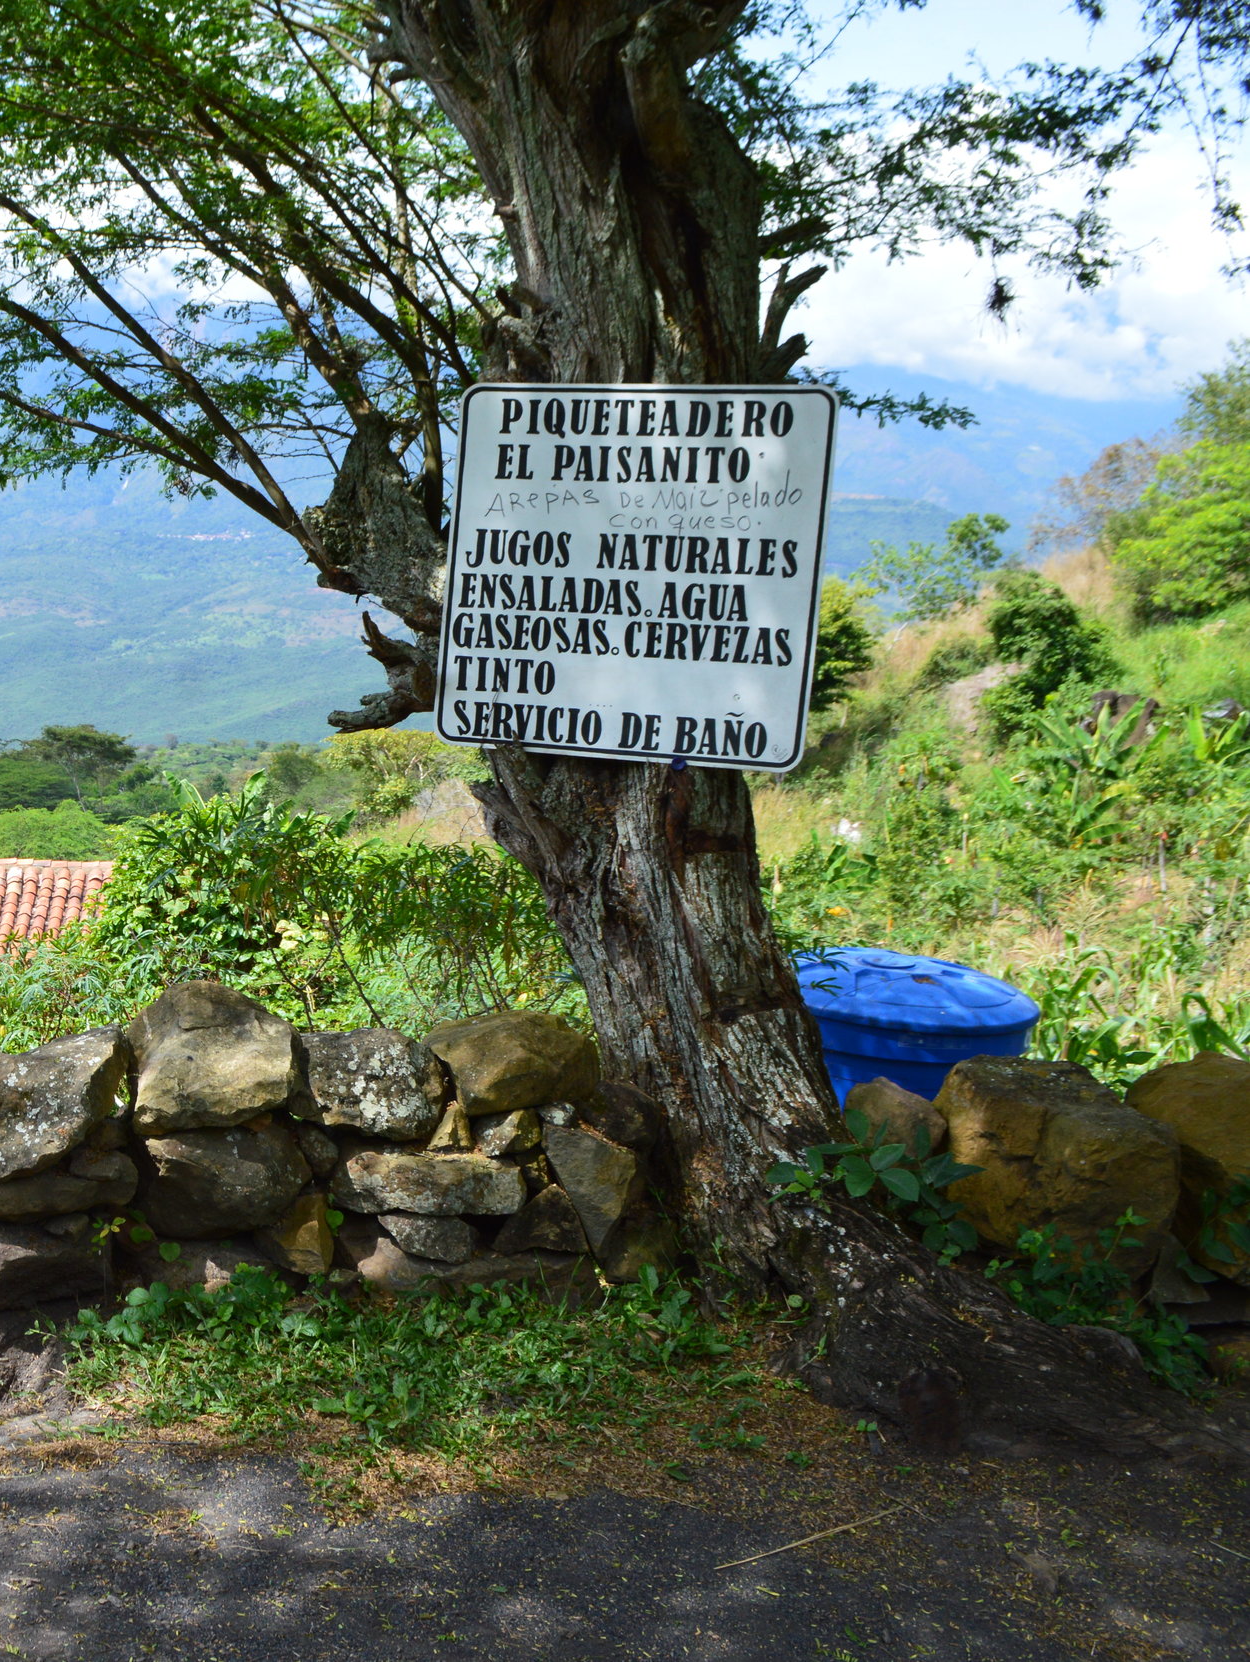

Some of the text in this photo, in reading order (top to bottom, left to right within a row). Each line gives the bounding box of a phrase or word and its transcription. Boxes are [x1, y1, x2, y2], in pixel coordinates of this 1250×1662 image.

[499, 399, 794, 438] PIQUETEADERO
[495, 444, 751, 483] EL PAISANITO
[727, 468, 803, 514] pelado
[466, 529, 798, 578] JUGOS NATURALES
[454, 656, 555, 695] TINTO
[454, 700, 767, 759] SERVICIO DE BAÑO
